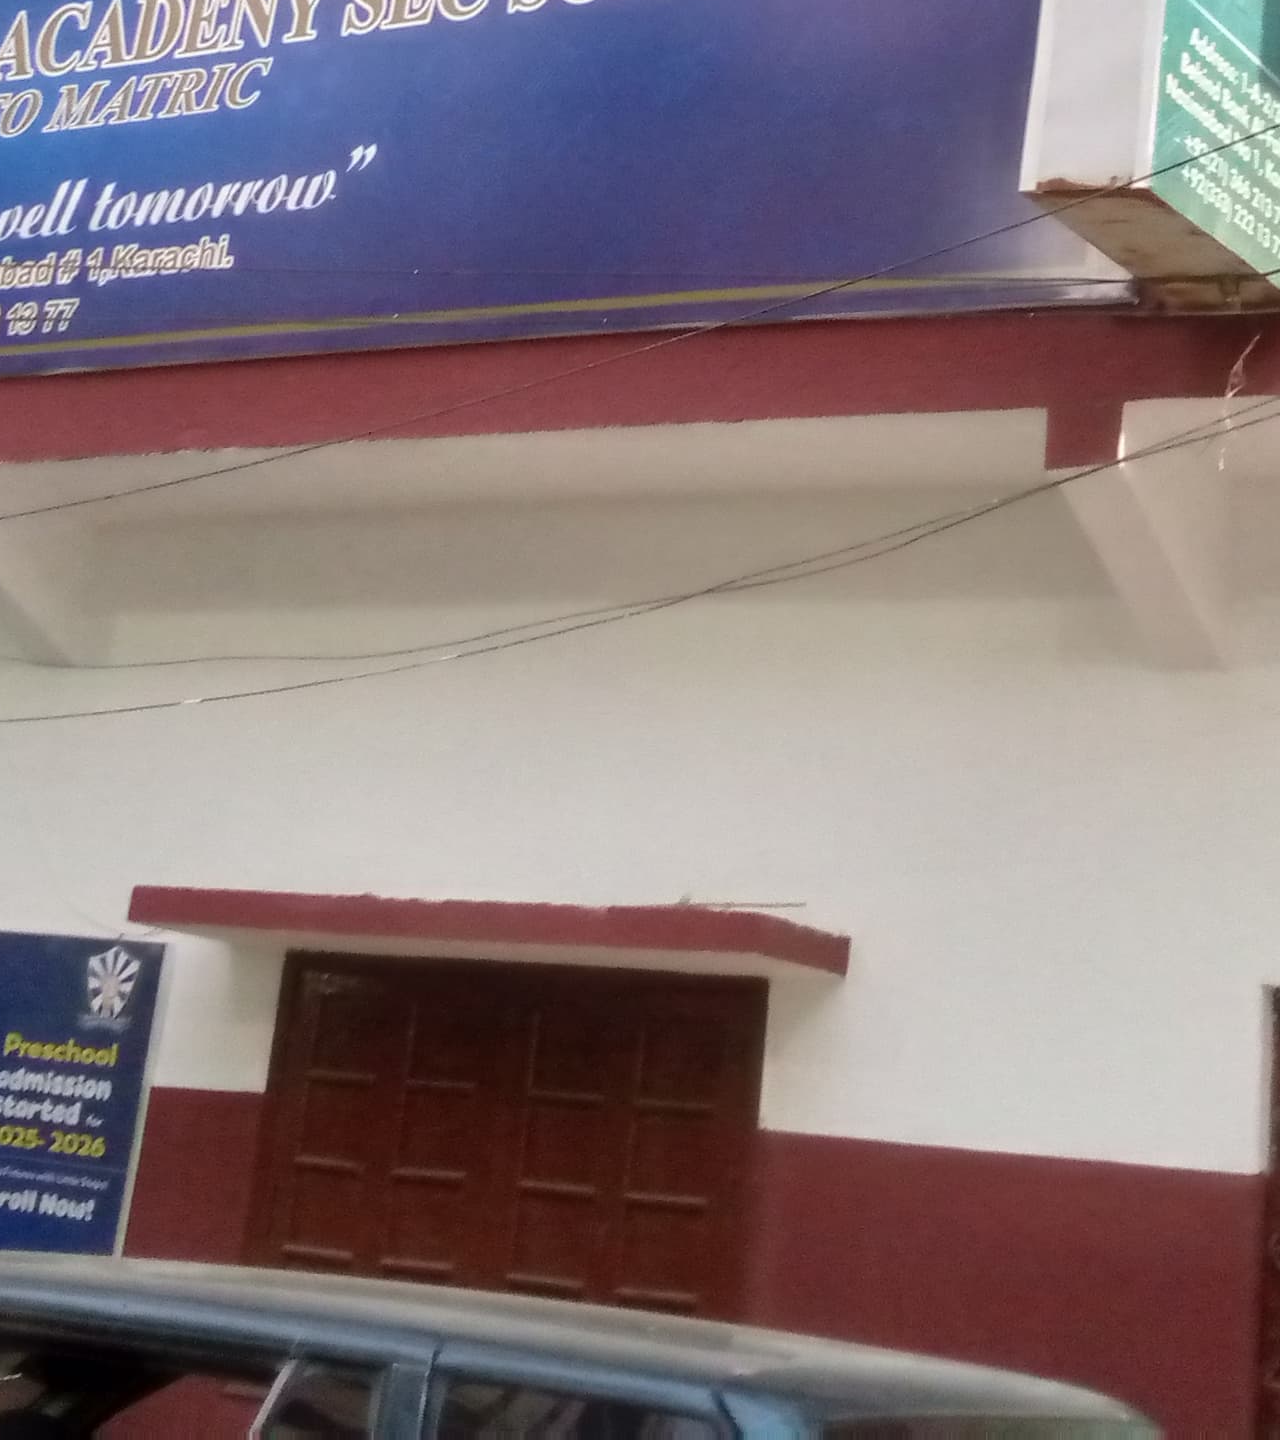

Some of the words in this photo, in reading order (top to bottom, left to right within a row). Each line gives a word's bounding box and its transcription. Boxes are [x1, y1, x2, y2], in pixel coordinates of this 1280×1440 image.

[44, 56, 274, 133] MATRIC
[55, 247, 84, 286] #
[41, 297, 81, 335] 77
[3, 1031, 120, 1068] Preschool
[38, 1192, 96, 1222] Now!
